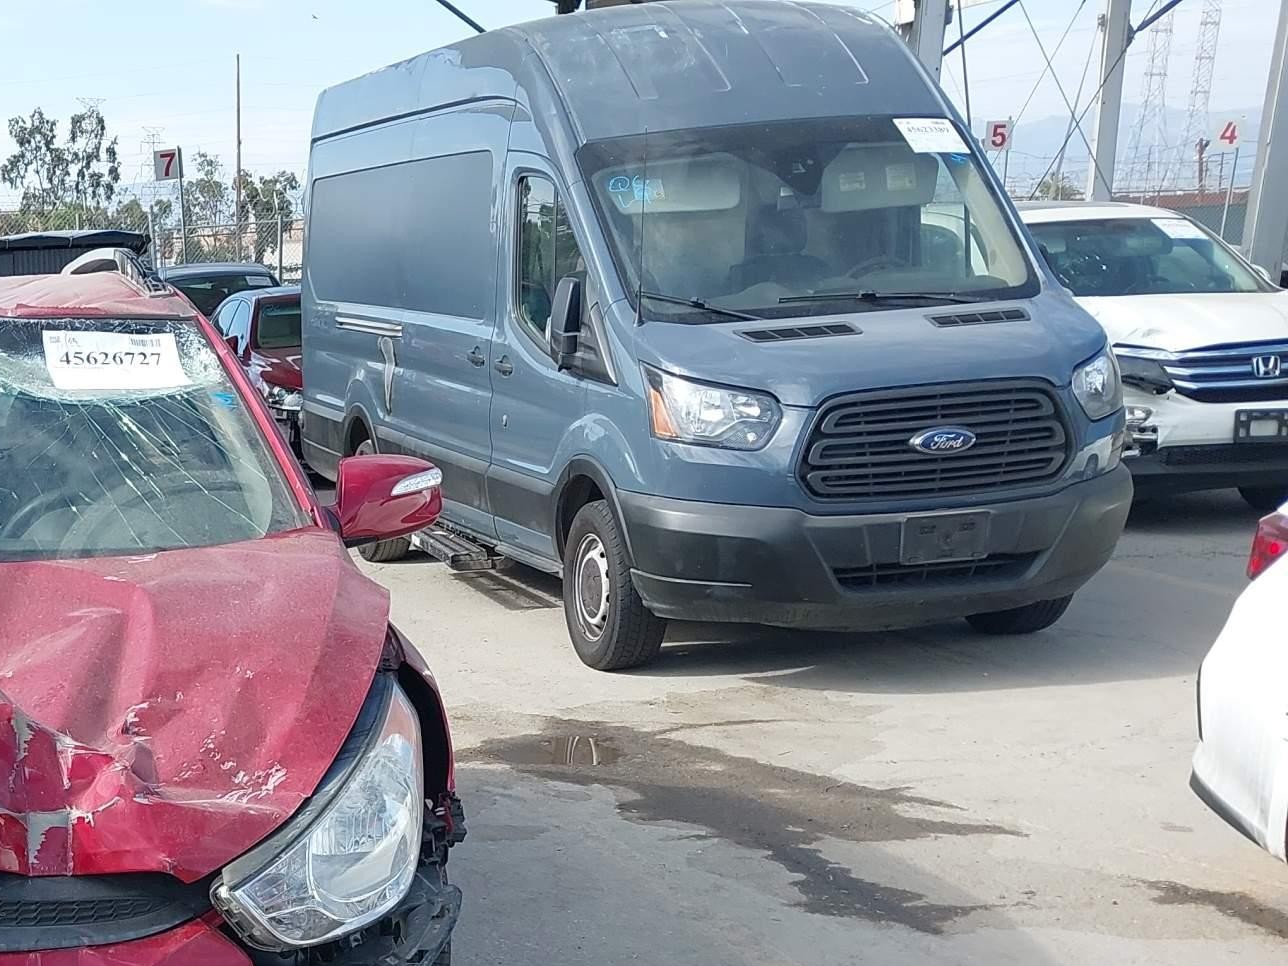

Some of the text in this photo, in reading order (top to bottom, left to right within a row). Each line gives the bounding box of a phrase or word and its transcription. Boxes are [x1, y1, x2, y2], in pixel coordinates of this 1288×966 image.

[991, 124, 1007, 148] 5
[1220, 121, 1237, 145] 4
[159, 152, 176, 177] 7
[59, 351, 161, 366] 45626727
[930, 433, 965, 450] Ford
